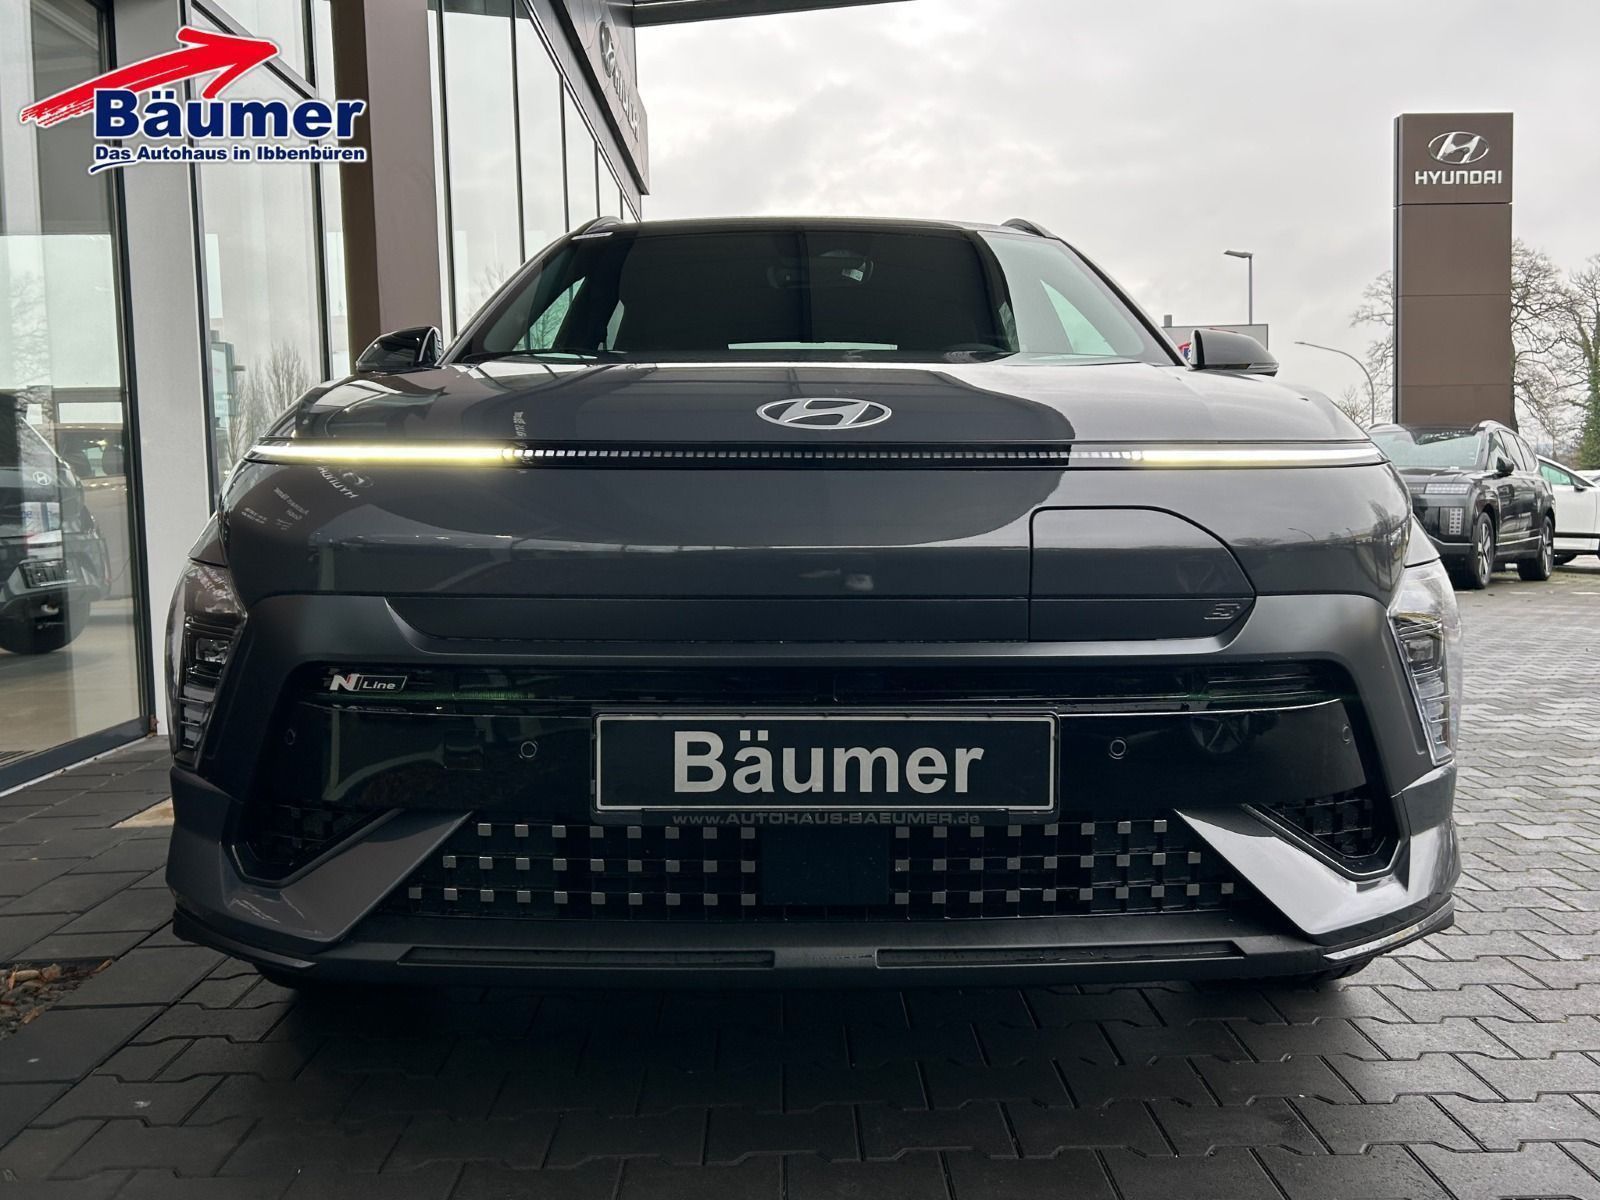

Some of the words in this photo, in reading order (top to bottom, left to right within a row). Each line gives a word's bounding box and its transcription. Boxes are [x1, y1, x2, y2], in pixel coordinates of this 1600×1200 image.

[1414, 170, 1502, 185] HYUNDAI
[329, 673, 360, 691] N
[362, 681, 396, 690] Line
[673, 729, 985, 794] Bäumer
[672, 812, 980, 825] www.AUTOHAUS-BAEUMER.de
